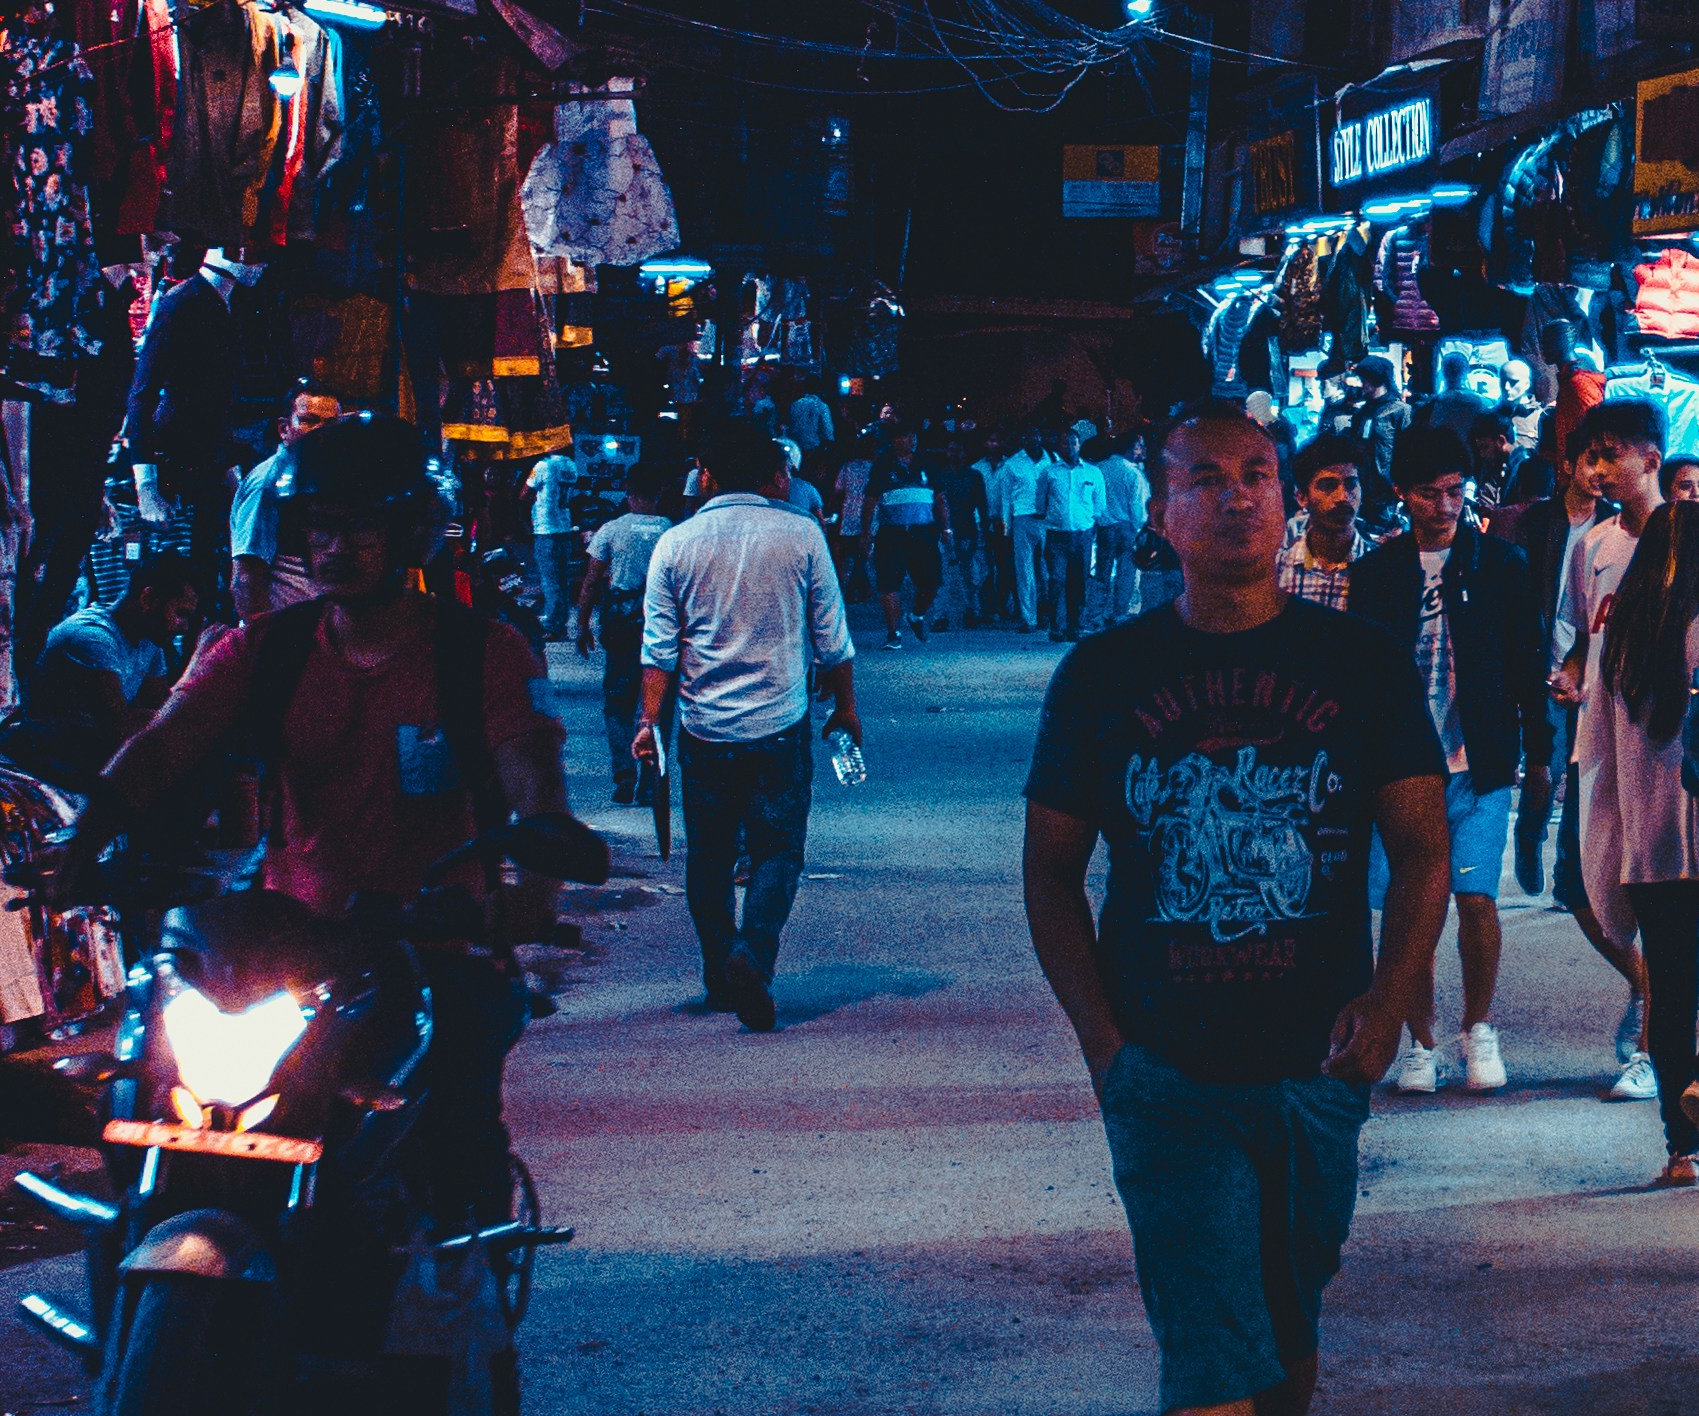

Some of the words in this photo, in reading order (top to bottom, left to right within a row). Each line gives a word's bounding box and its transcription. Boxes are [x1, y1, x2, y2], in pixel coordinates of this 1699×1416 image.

[1333, 123, 1362, 183] STYLE
[1366, 98, 1431, 173] COLLECTION
[1134, 666, 1341, 740] AUTHENTIC
